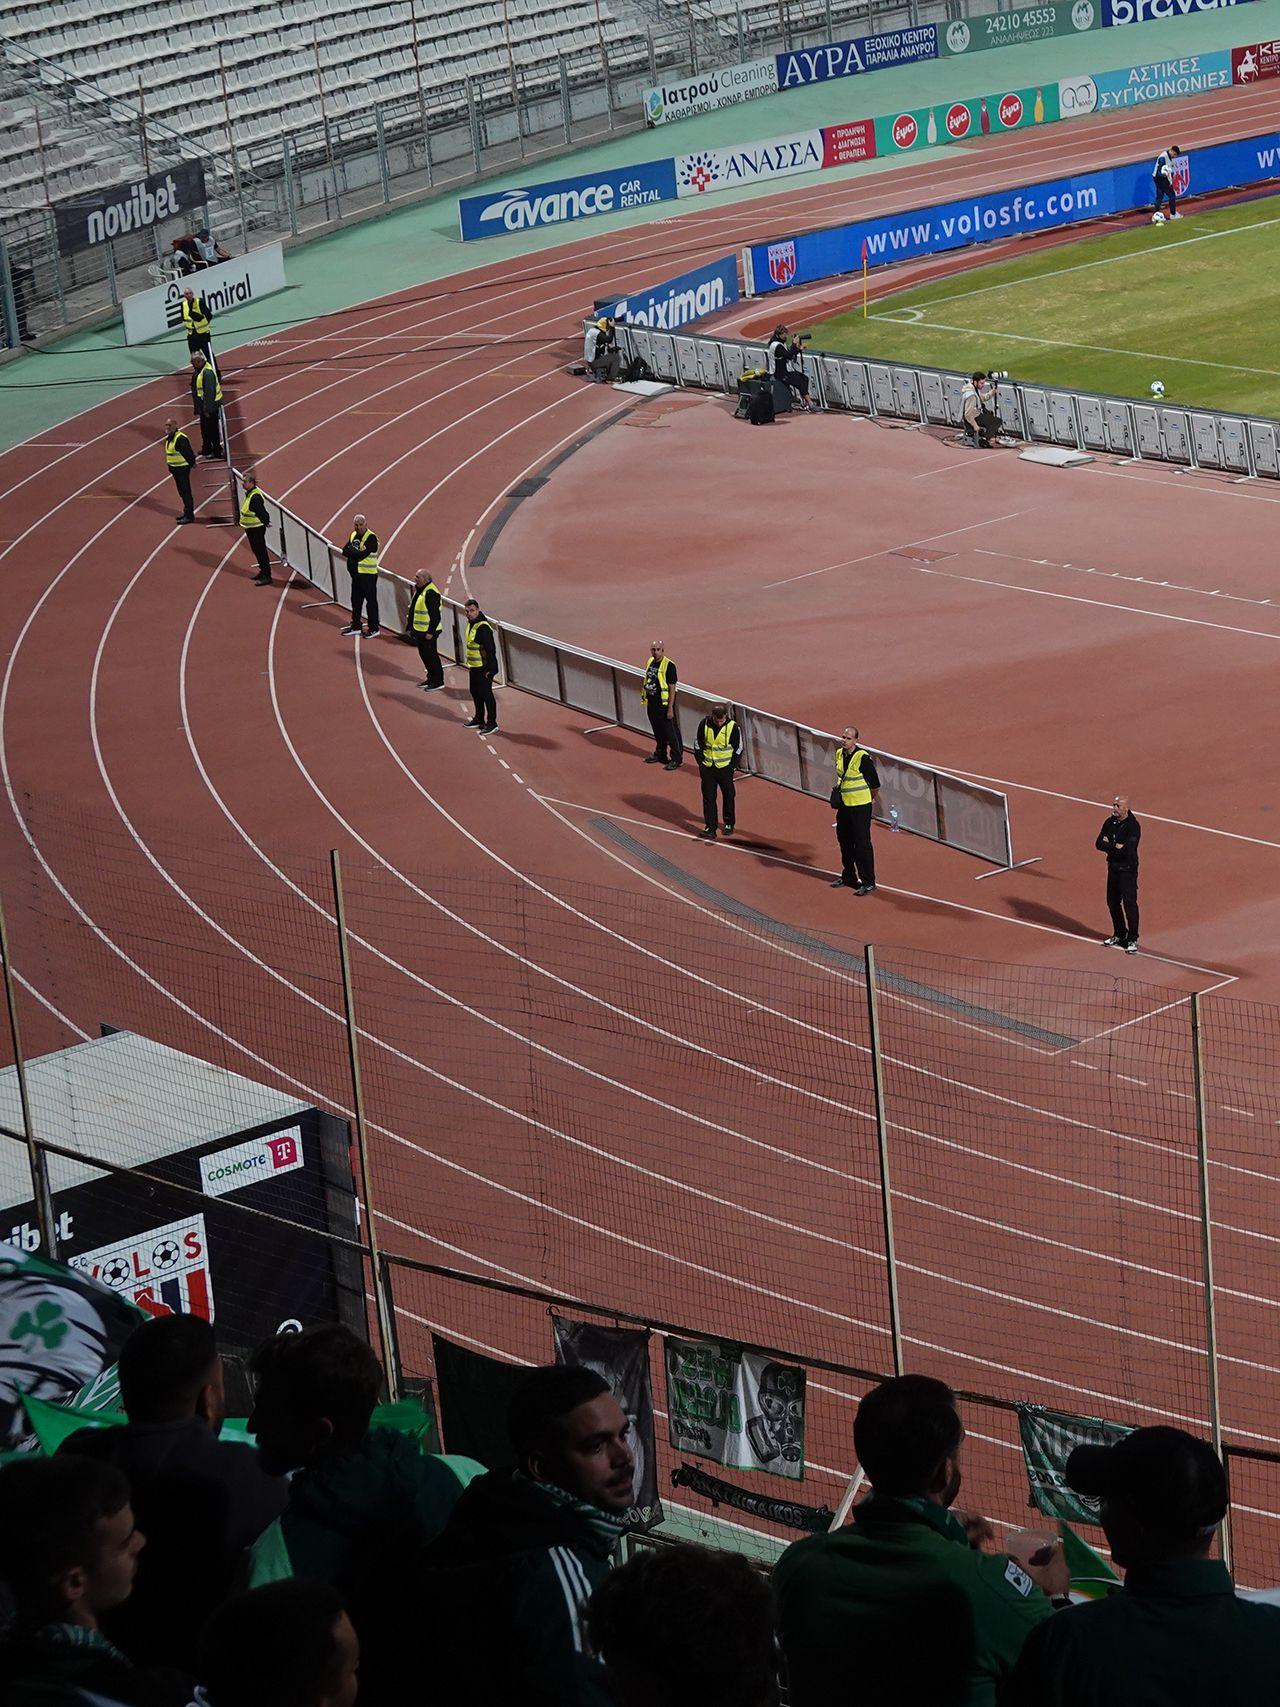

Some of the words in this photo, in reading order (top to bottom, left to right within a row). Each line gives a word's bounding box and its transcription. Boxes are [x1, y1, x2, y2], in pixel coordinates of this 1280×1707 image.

[985, 13, 1020, 34] 24210
[1022, 8, 1056, 27] 45553
[864, 33, 900, 53] ΕΞΟΧΙΚΟ
[902, 27, 935, 45] ΚΕΝΤΡΟ
[866, 49, 900, 66] ΠΑΡΑΛΙΑ
[900, 41, 936, 58] ΑΝΑΥΡΟΥ
[720, 63, 776, 89] Cleaning
[782, 43, 866, 87] ΑΥΡΑ
[1128, 57, 1201, 85] ΑΣΤΙΚΕΣ
[662, 73, 719, 106] Ιατρού
[665, 100, 712, 122] ΚΑΘΑΡΙΣΜΟΙ
[744, 82, 778, 100] ΕΜΠΟΡΙΟ
[1100, 70, 1229, 108] ΣΥΓΚΟΙΝΩΝΙΕΣ
[619, 180, 641, 195] CAR
[620, 188, 661, 208] RENTAL
[87, 174, 180, 244] novibet
[503, 183, 614, 231] avance
[866, 186, 1097, 255] www.volosfc.com
[207, 1154, 267, 1182] COSMOTE
